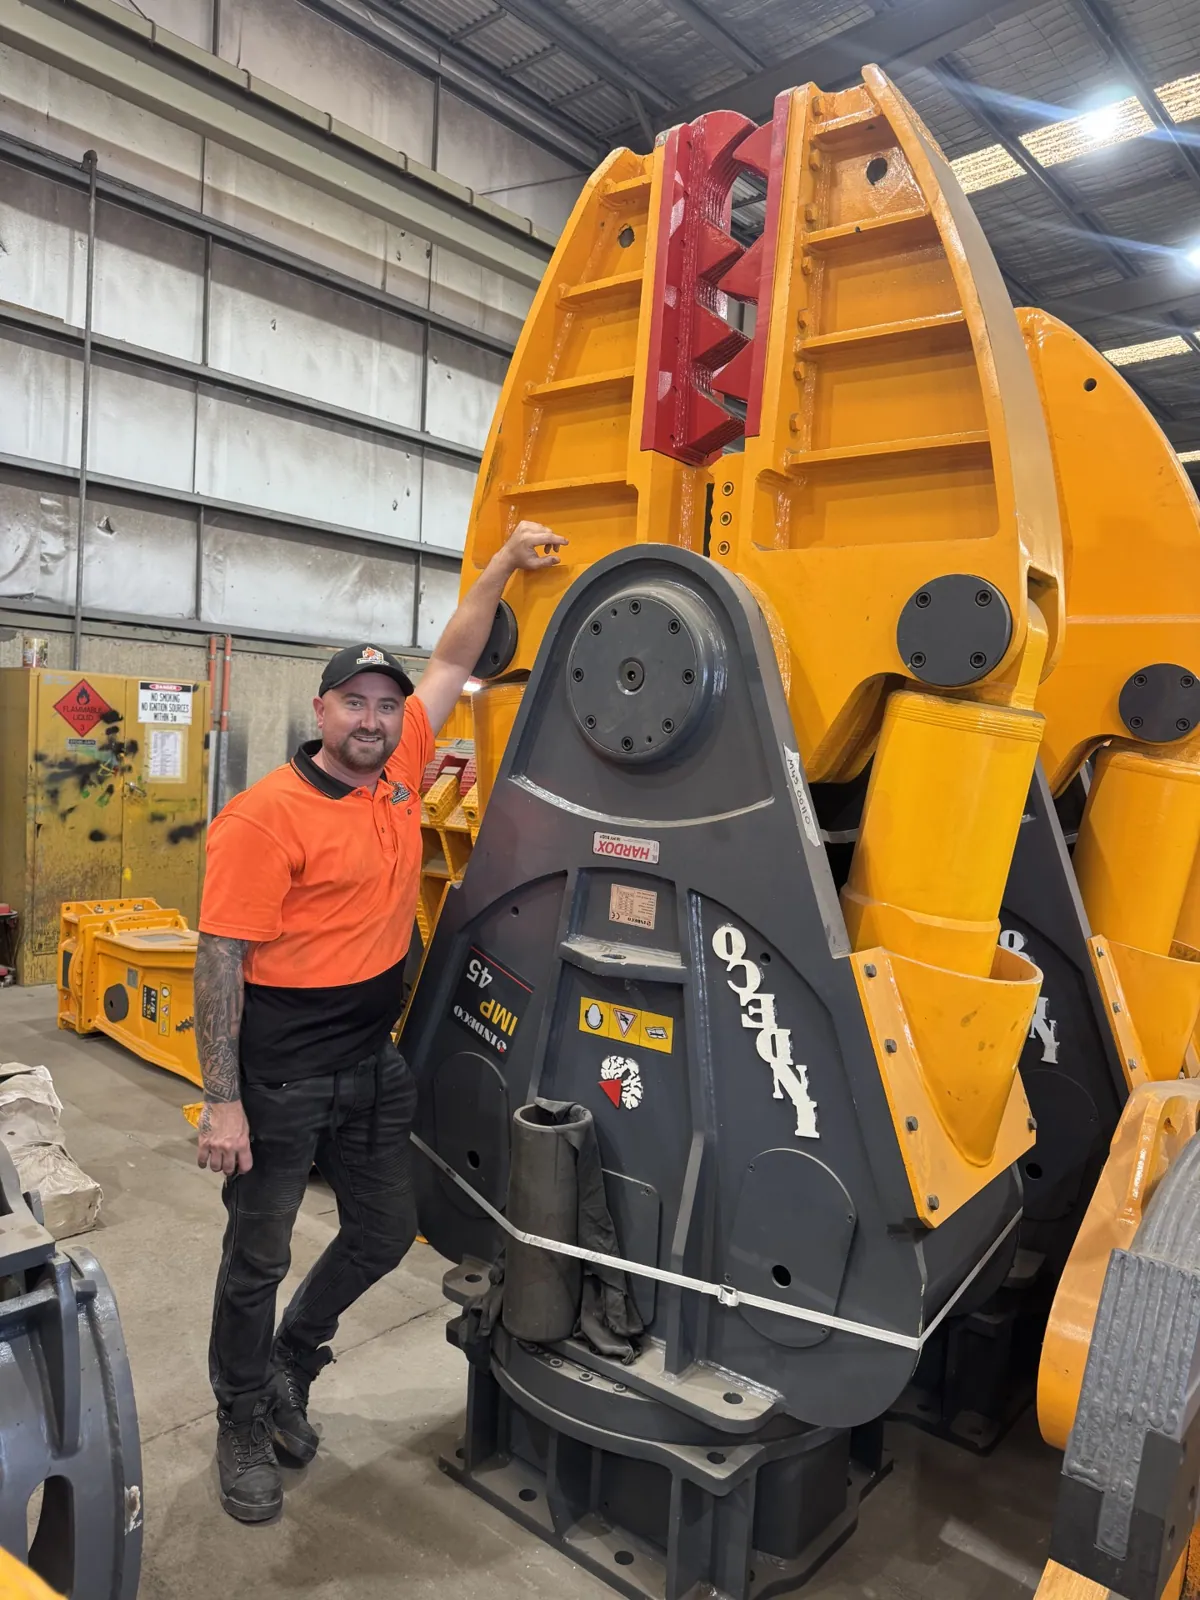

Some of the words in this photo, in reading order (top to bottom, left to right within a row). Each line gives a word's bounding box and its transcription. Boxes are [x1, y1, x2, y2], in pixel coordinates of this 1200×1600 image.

[62, 705, 103, 714] FLAMMABLE
[141, 702, 149, 711] NO
[149, 702, 168, 712] IGNITION
[169, 703, 189, 713] SOURCES
[150, 692, 158, 701] NO
[159, 693, 181, 703] SMOKING
[597, 841, 649, 860] HARDOX
[466, 959, 493, 989] 45
[453, 1005, 499, 1046] INDECO
[480, 998, 518, 1037] IMP
[712, 925, 820, 1138] INDECO
